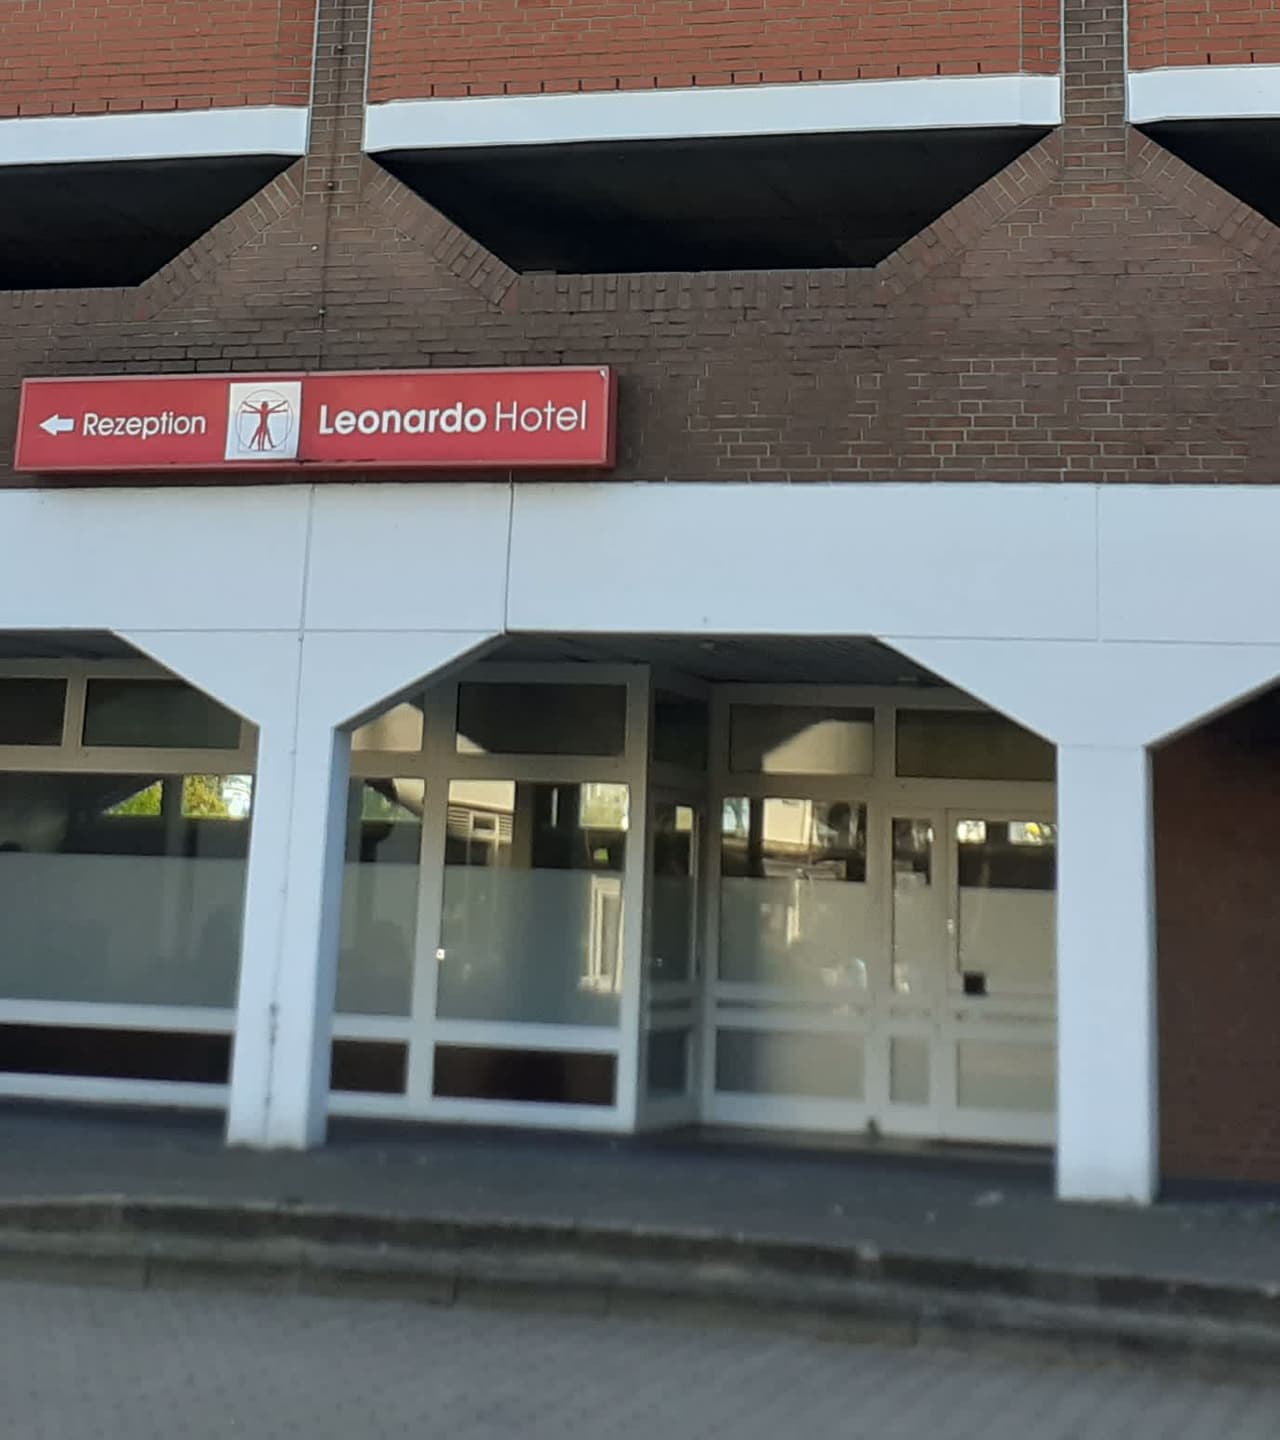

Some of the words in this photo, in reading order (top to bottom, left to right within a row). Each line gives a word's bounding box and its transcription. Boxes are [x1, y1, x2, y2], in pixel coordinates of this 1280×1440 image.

[82, 411, 207, 440] Rezeption
[319, 401, 487, 435] Leonardo
[494, 399, 587, 432] Hotel
